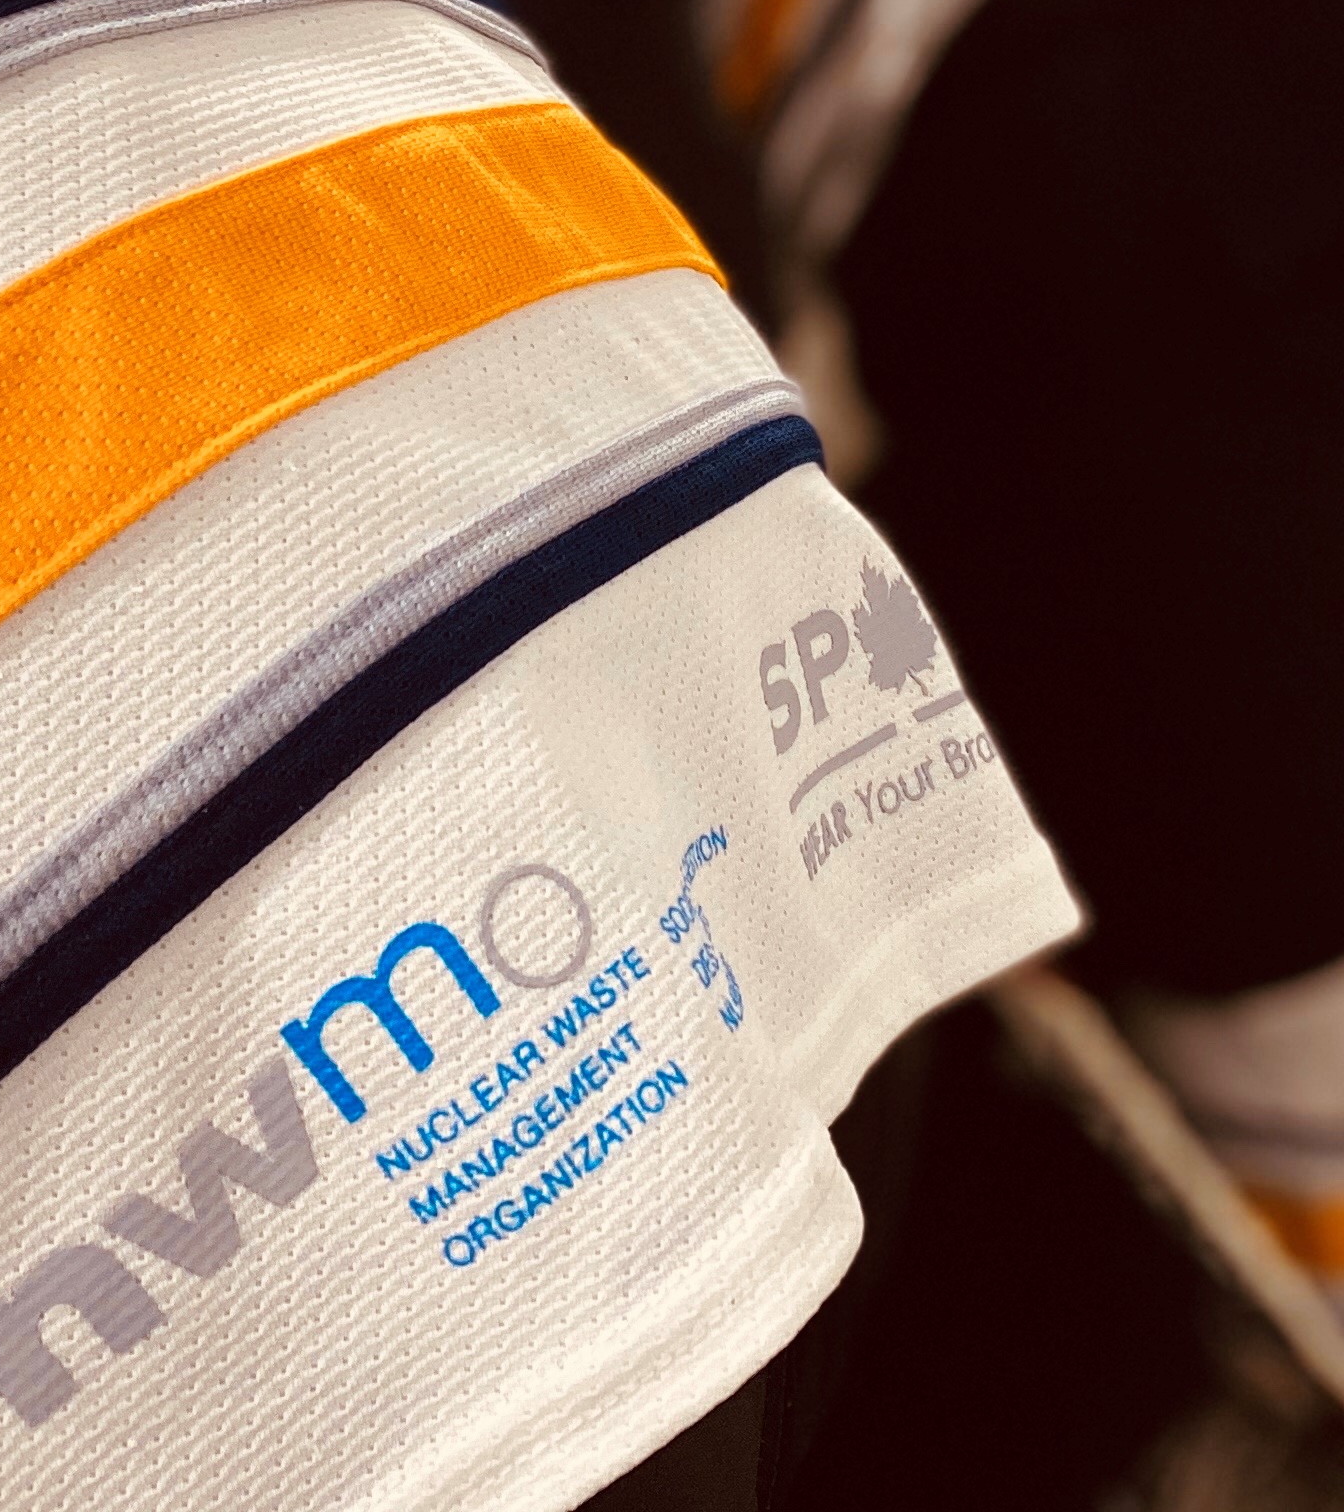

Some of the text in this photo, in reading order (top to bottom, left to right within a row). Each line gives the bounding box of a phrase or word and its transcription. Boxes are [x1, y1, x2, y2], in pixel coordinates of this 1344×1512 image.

[799, 800, 853, 882] WEAR
[854, 755, 934, 825] Your
[375, 1039, 546, 1181] NUCLEAR
[540, 945, 652, 1048] WASTE
[407, 1020, 642, 1225] MANAGEMENT
[441, 1058, 690, 1267] ORGANIZATION
